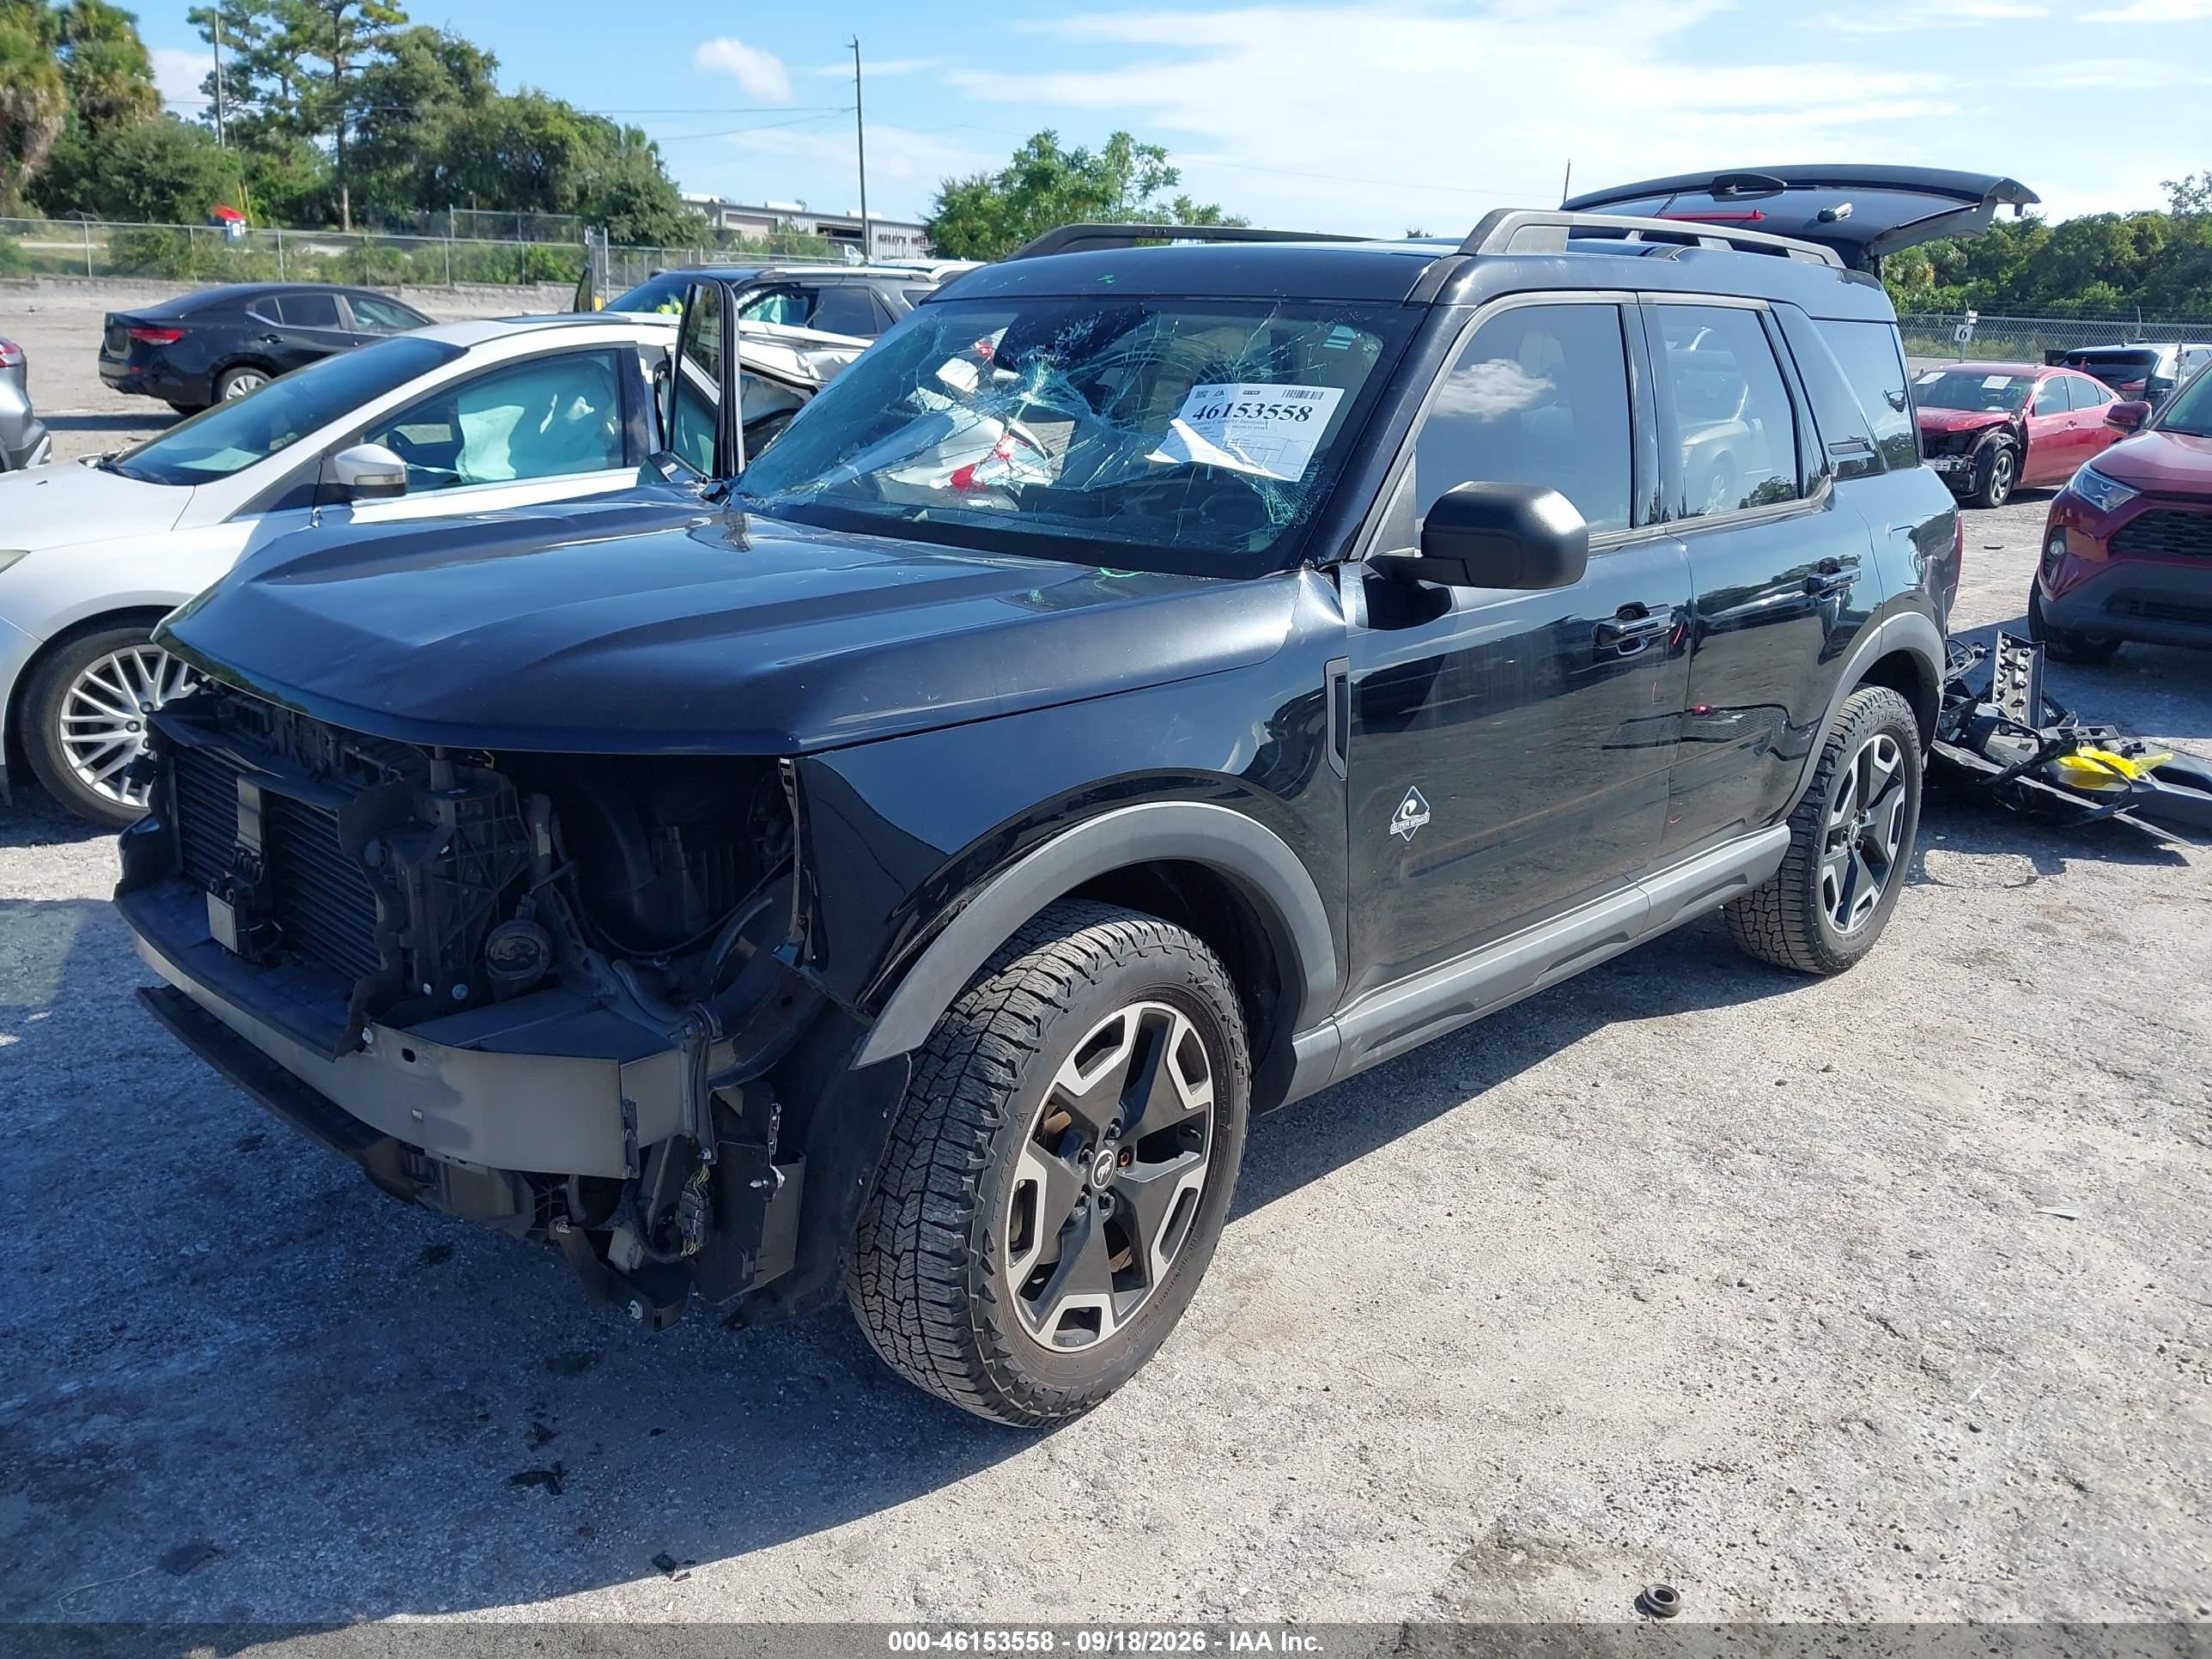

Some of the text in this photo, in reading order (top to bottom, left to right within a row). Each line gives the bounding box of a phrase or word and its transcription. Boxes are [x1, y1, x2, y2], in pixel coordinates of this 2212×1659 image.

[1959, 327, 1969, 340] 6
[1192, 402, 1313, 422] 46153558
[1392, 816, 1429, 832] OUTER BANKS
